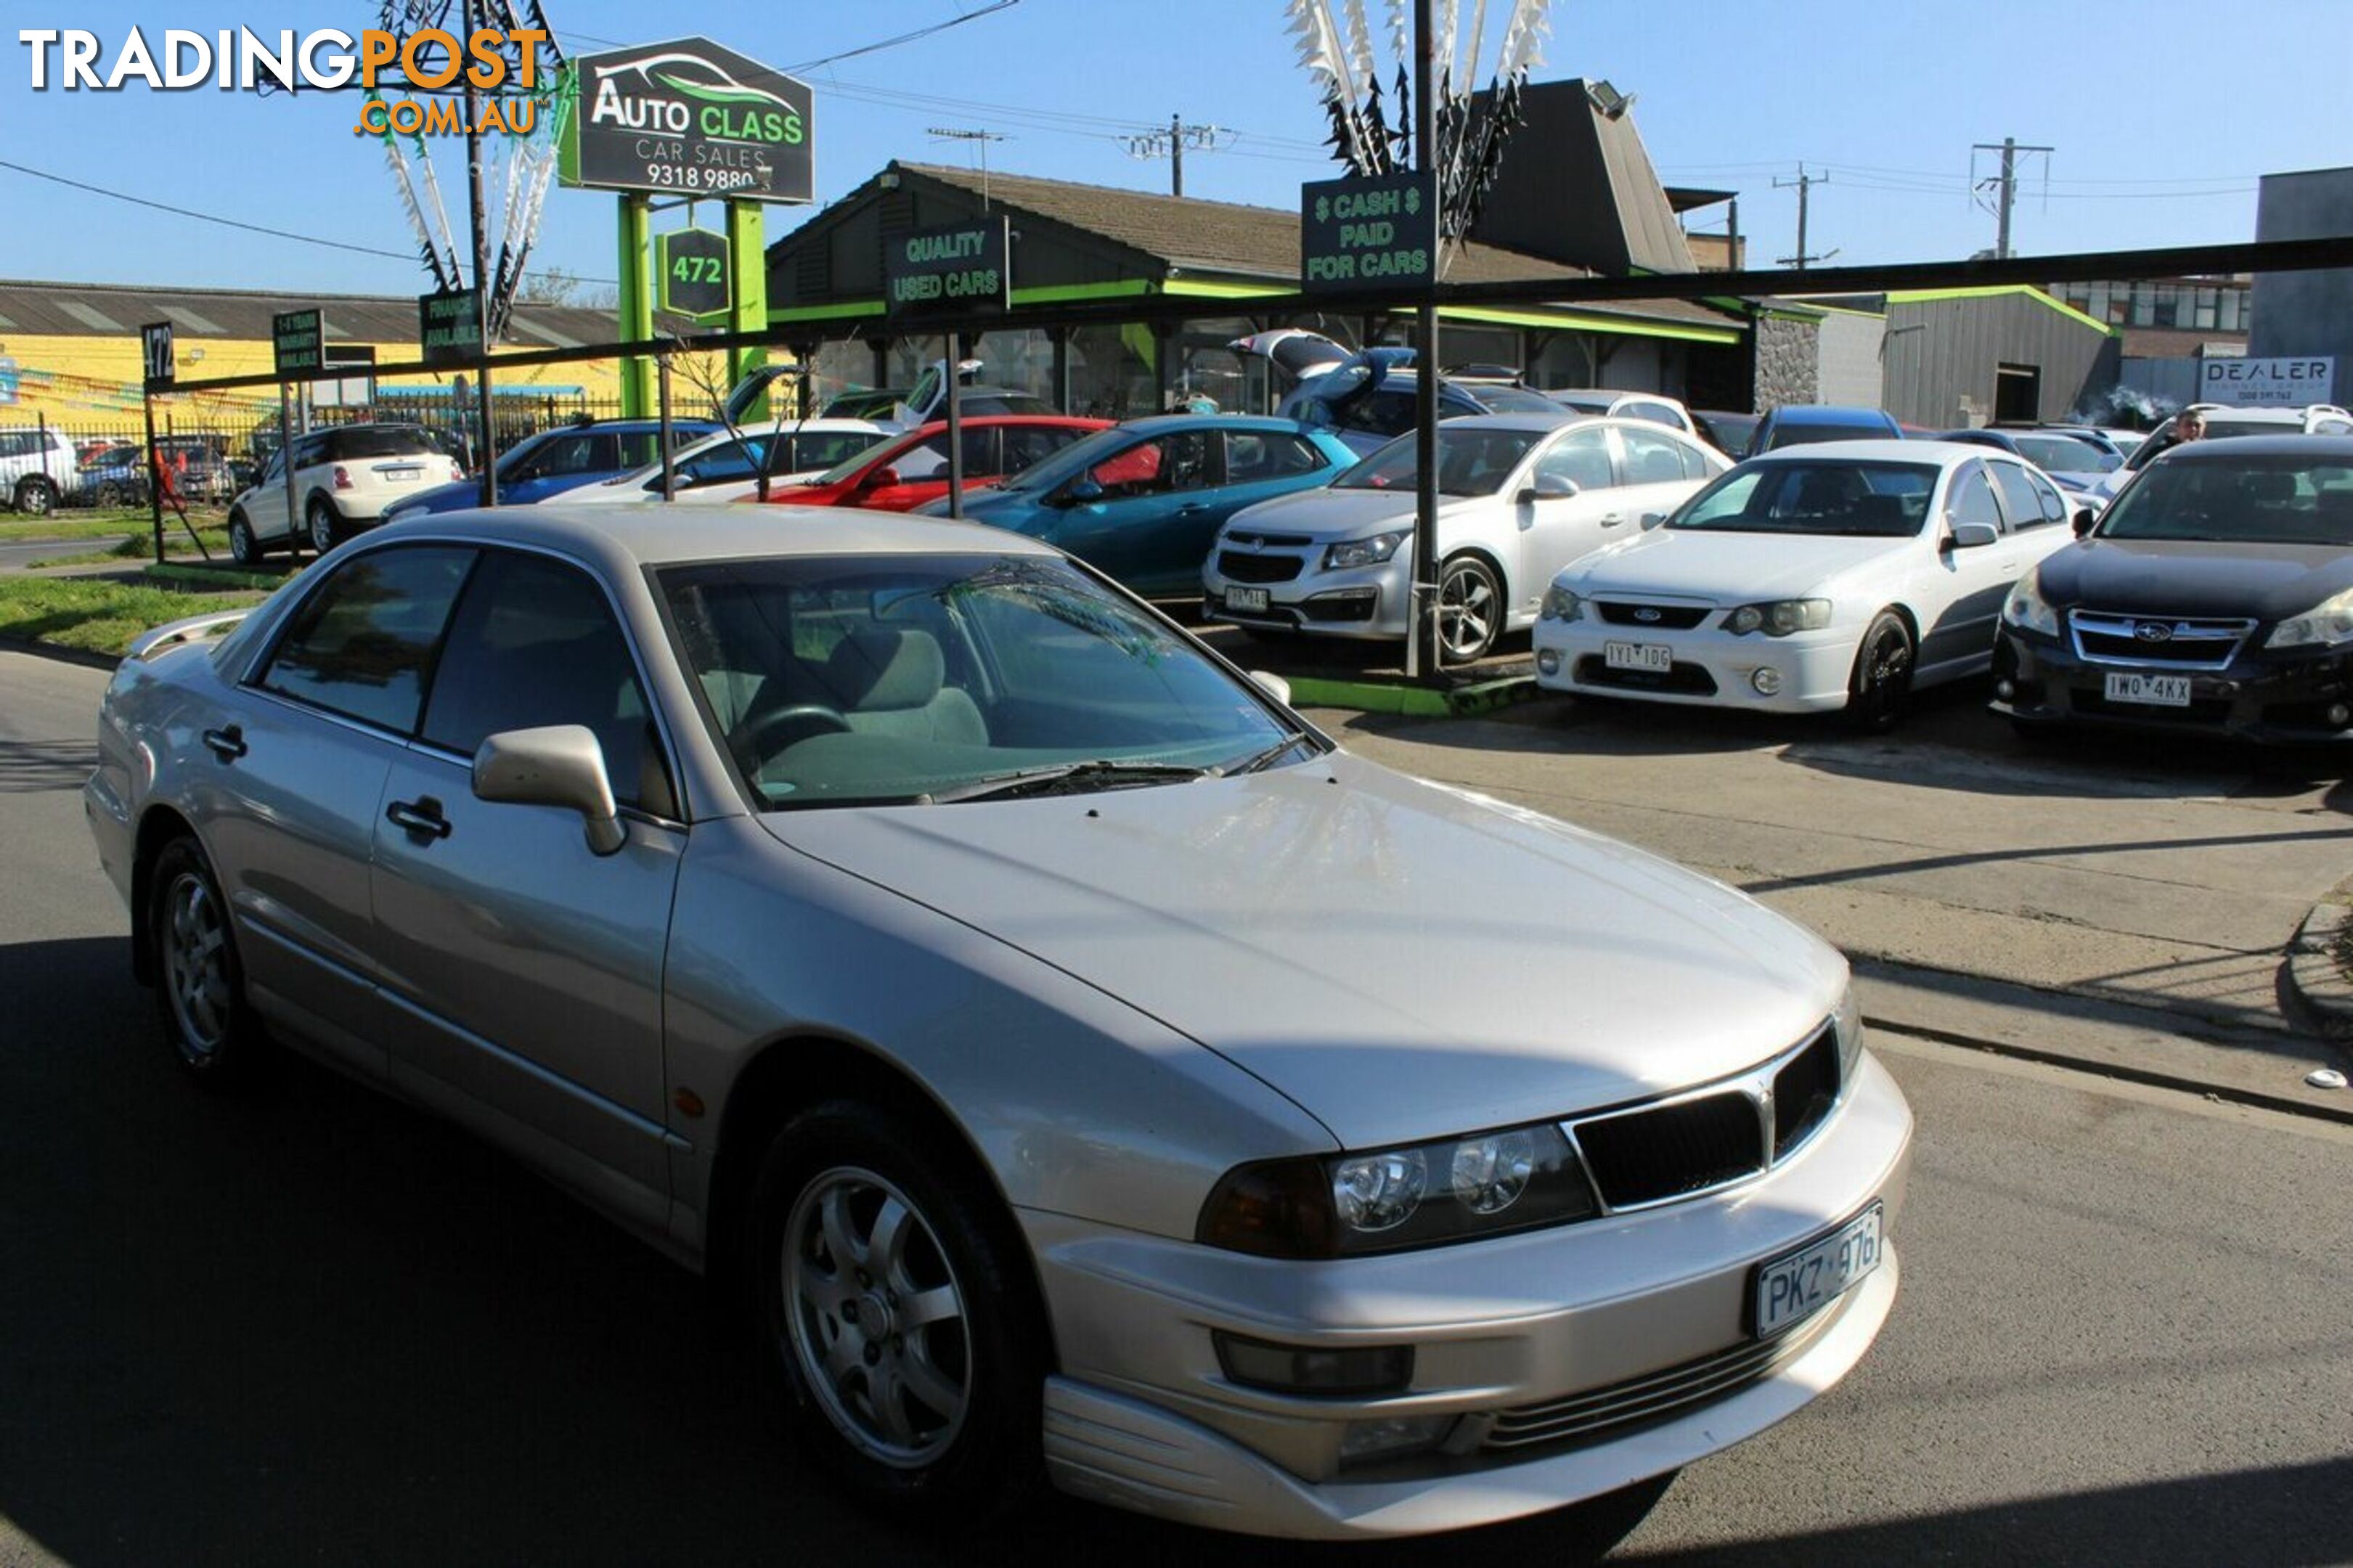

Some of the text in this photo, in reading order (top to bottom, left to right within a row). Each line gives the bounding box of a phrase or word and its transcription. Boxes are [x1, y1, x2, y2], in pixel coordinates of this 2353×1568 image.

[700, 106, 803, 144] CLASS
[636, 139, 764, 168] CAR SALES
[647, 163, 698, 187] 9318
[1334, 189, 1400, 219] CASH
[906, 230, 985, 262] QUALITY
[1340, 222, 1394, 248] PAID
[673, 257, 722, 284] 472
[1307, 249, 1427, 281] FOR CARS
[893, 269, 999, 301] USED CARS
[144, 327, 174, 378] 472
[2207, 362, 2328, 380] DEALER
[2154, 679, 2187, 699] 4KX
[1769, 1230, 1875, 1322] PKZ 976
